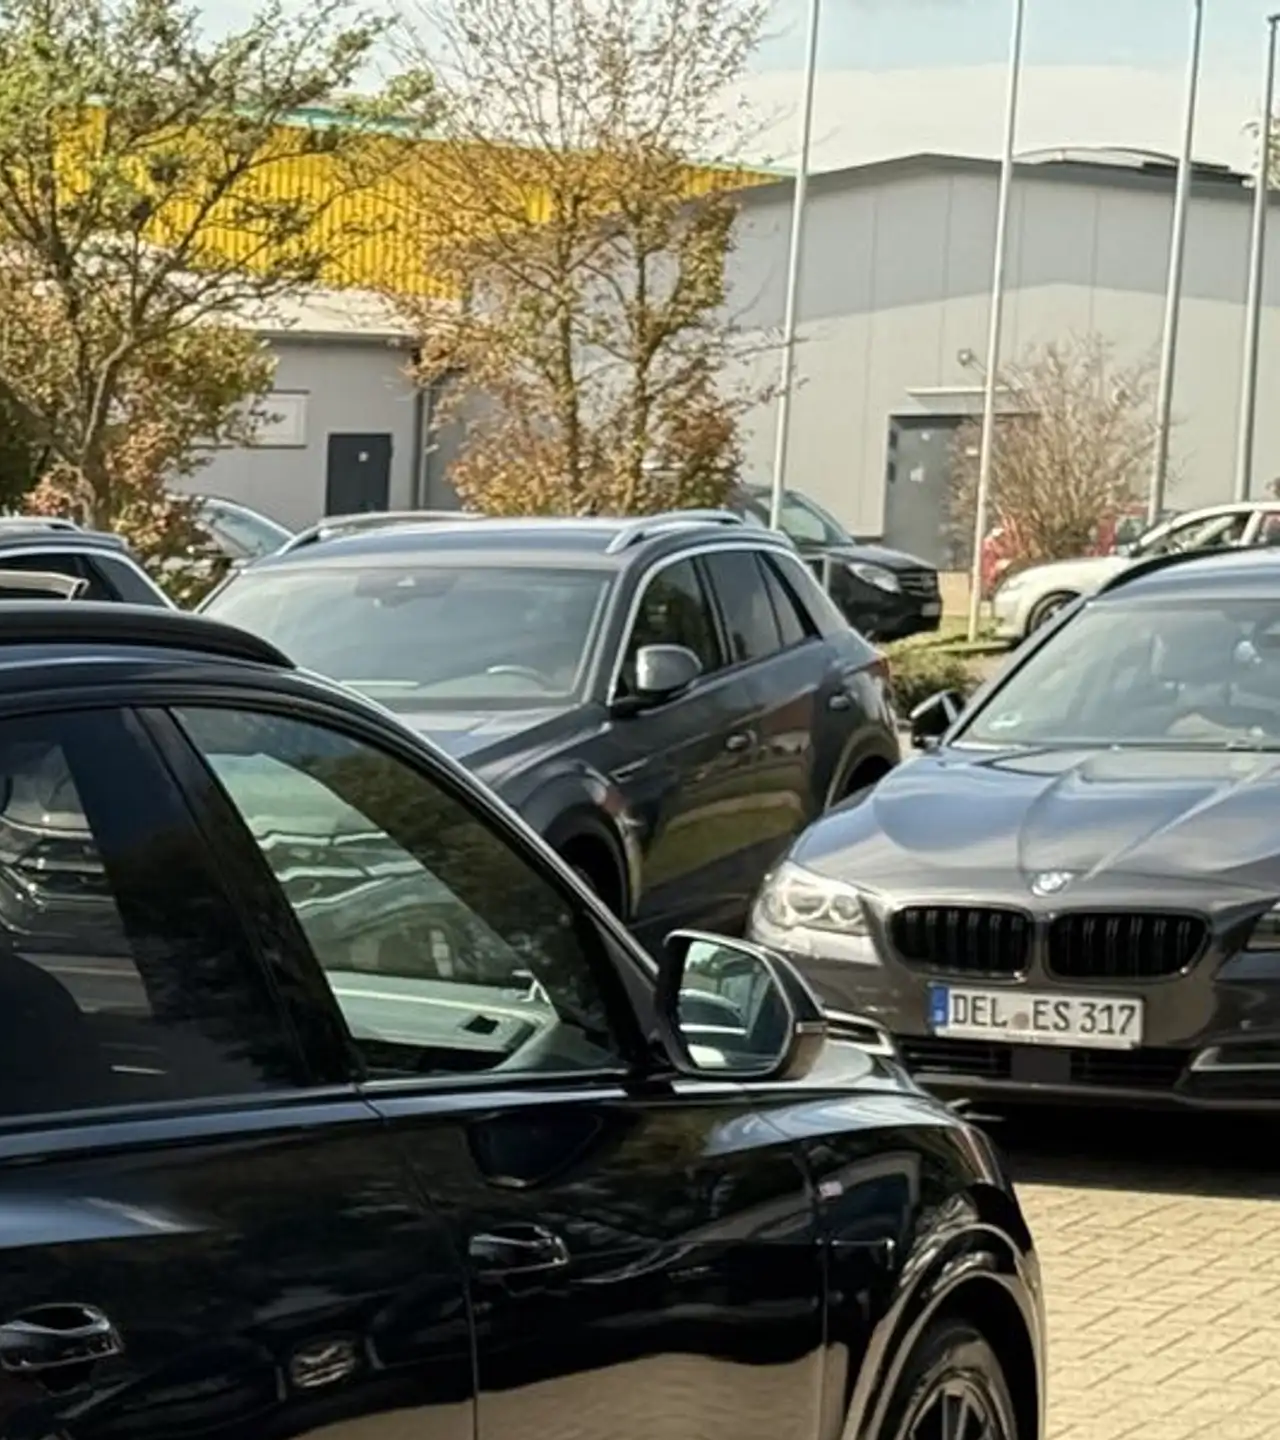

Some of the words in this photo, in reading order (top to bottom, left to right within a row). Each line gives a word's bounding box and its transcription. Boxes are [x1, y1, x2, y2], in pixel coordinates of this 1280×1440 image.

[950, 993, 1008, 1029] DEL
[1032, 1000, 1071, 1033] ES
[1079, 1002, 1137, 1036] 317
